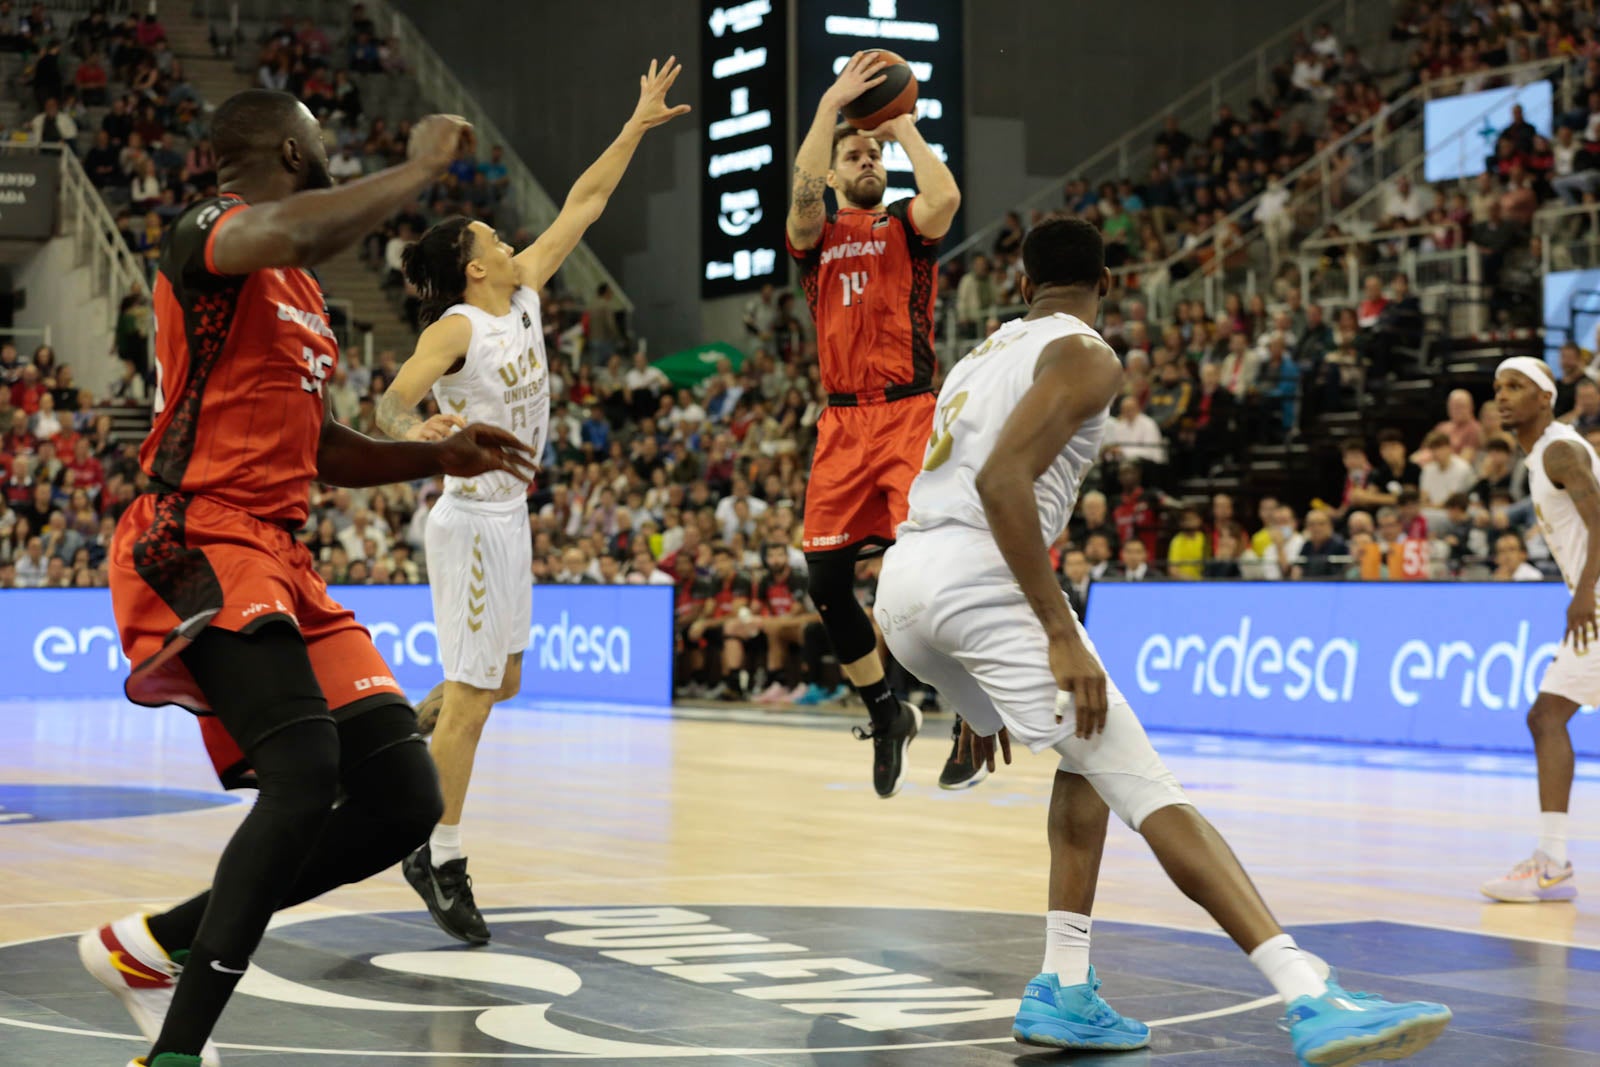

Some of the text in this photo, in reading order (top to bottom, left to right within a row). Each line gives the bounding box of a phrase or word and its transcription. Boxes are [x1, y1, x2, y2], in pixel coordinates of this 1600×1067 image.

[820, 240, 887, 265] VIRAN
[838, 271, 869, 307] 14
[498, 346, 542, 388] UCA
[529, 610, 631, 675] ndesa
[1135, 615, 1359, 703] endesa
